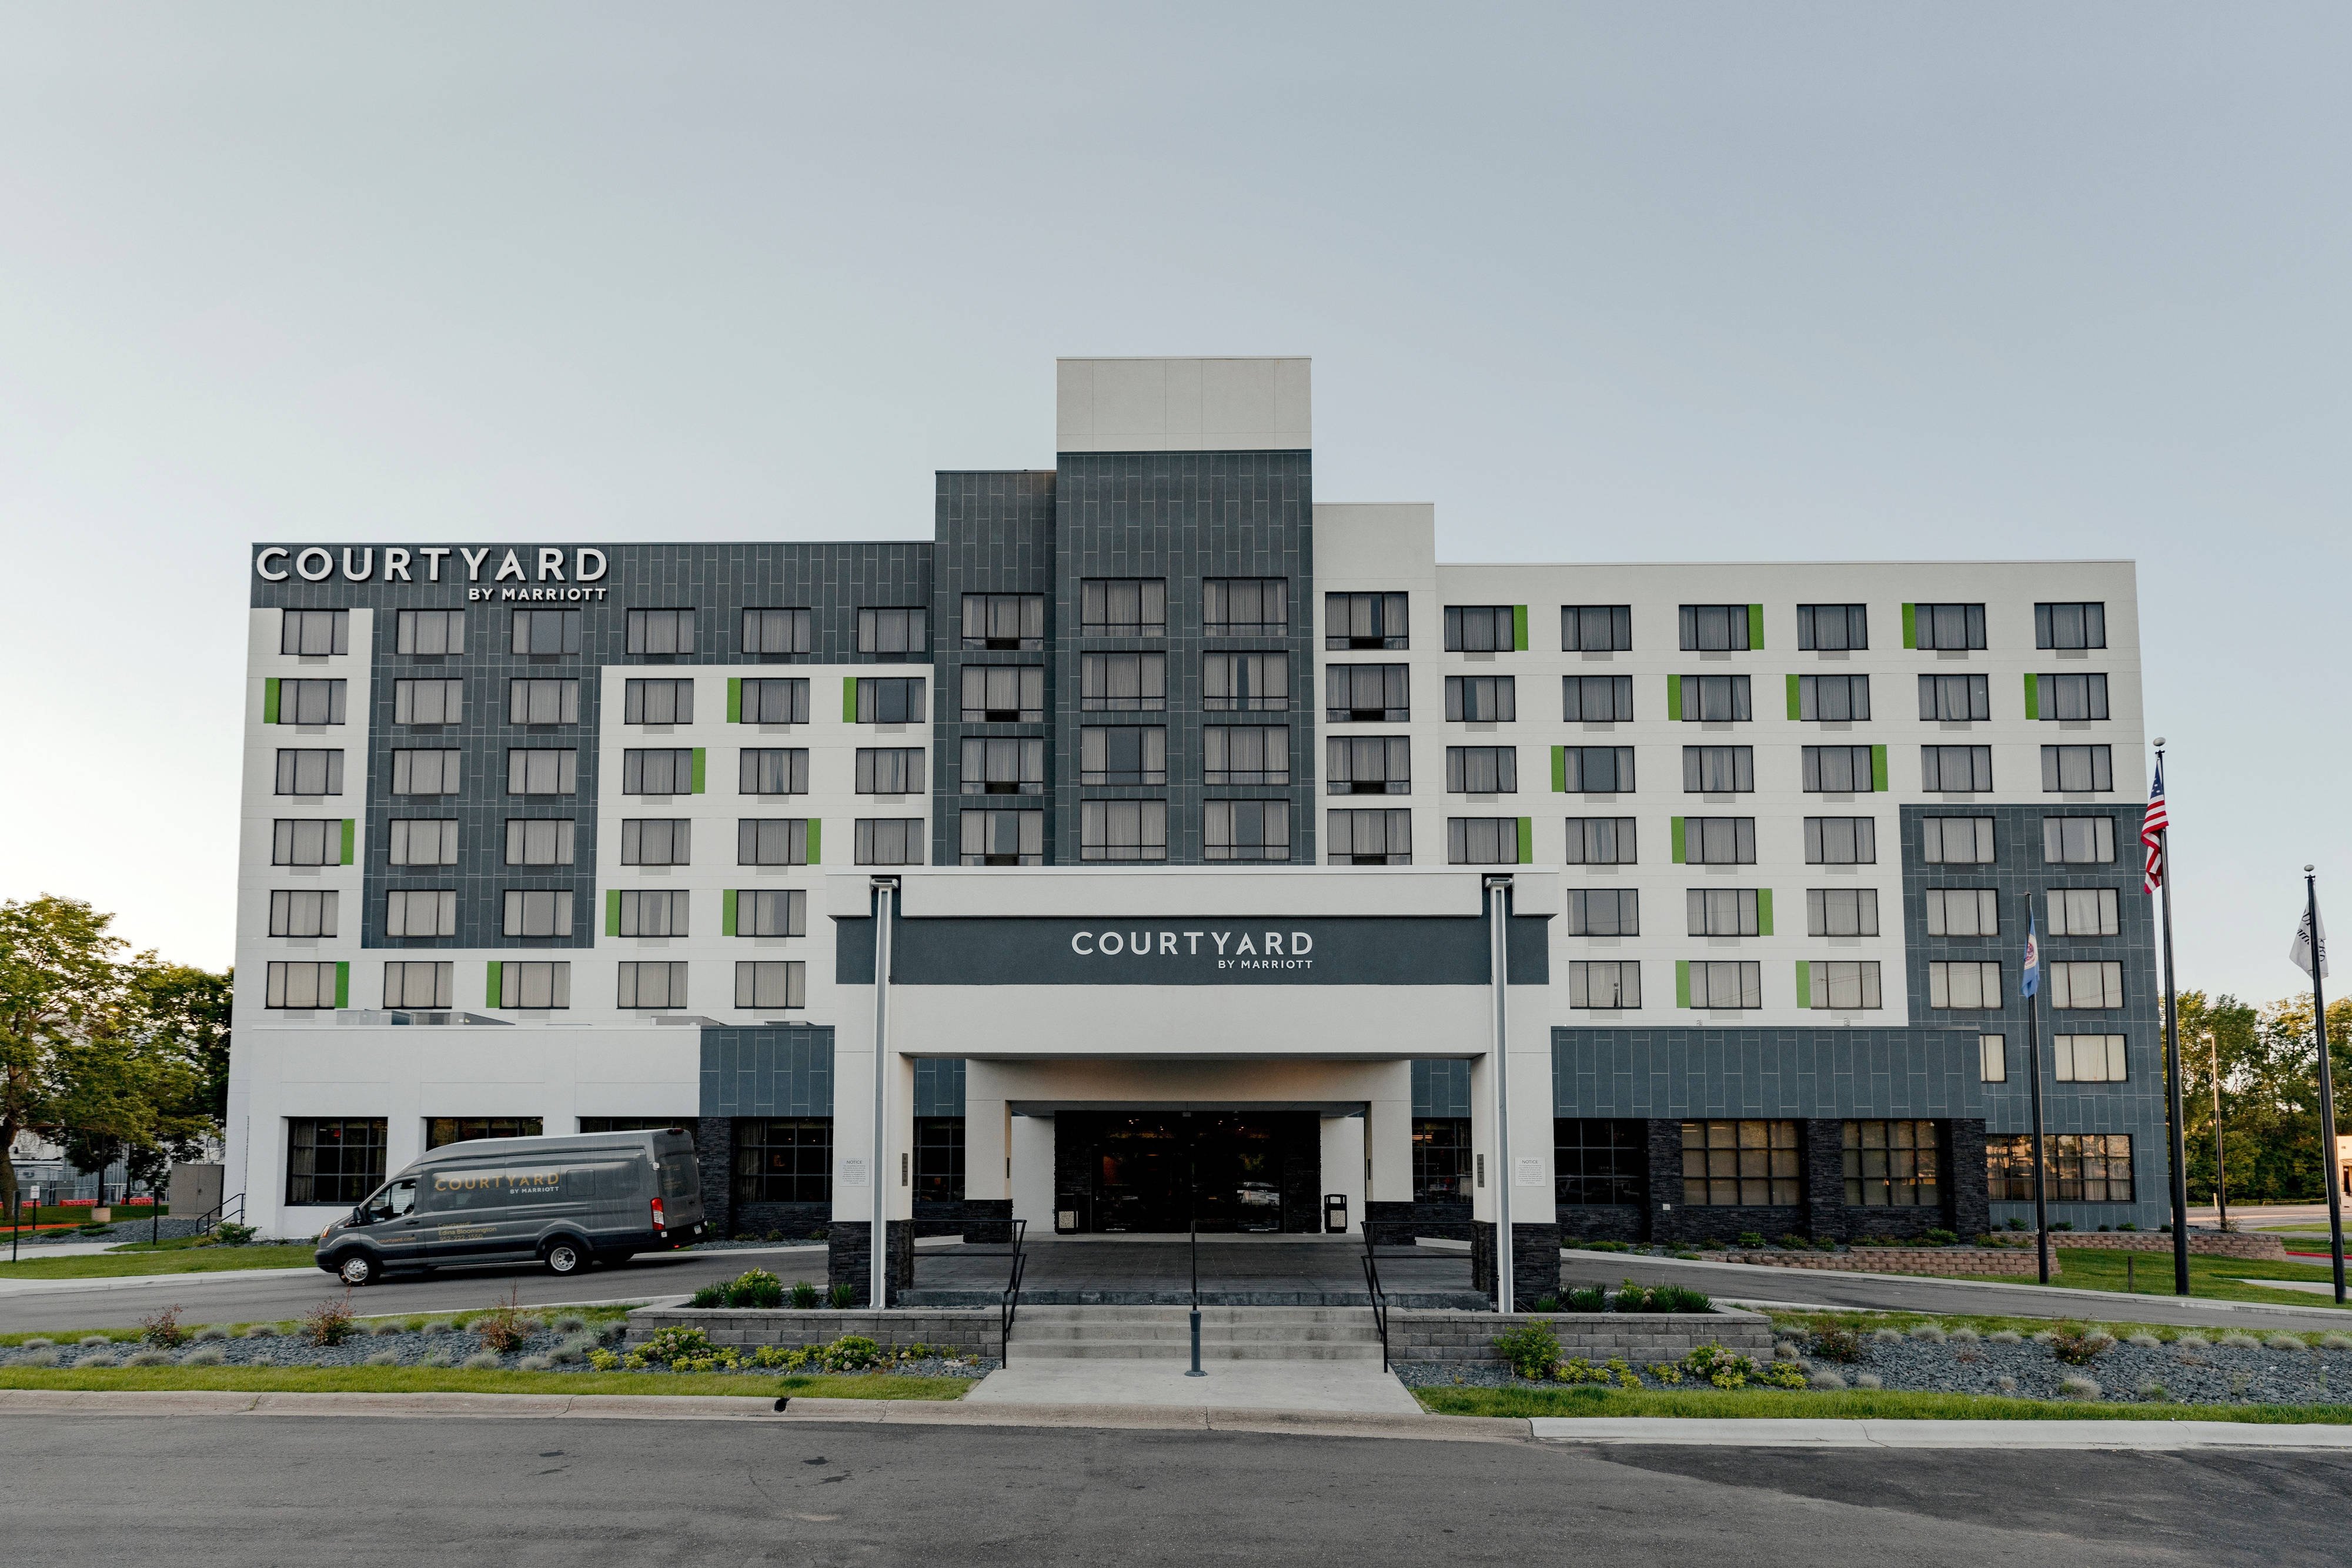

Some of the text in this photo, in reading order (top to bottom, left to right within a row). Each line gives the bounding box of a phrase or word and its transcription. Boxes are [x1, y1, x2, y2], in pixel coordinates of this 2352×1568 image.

[256, 547, 608, 581] COURTYARD
[469, 588, 607, 600] BY MARRIOTT
[1071, 931, 1312, 955] COURTYARD
[1218, 959, 1313, 969] BY MARRIOTT
[435, 1172, 559, 1191] COURTYARD
